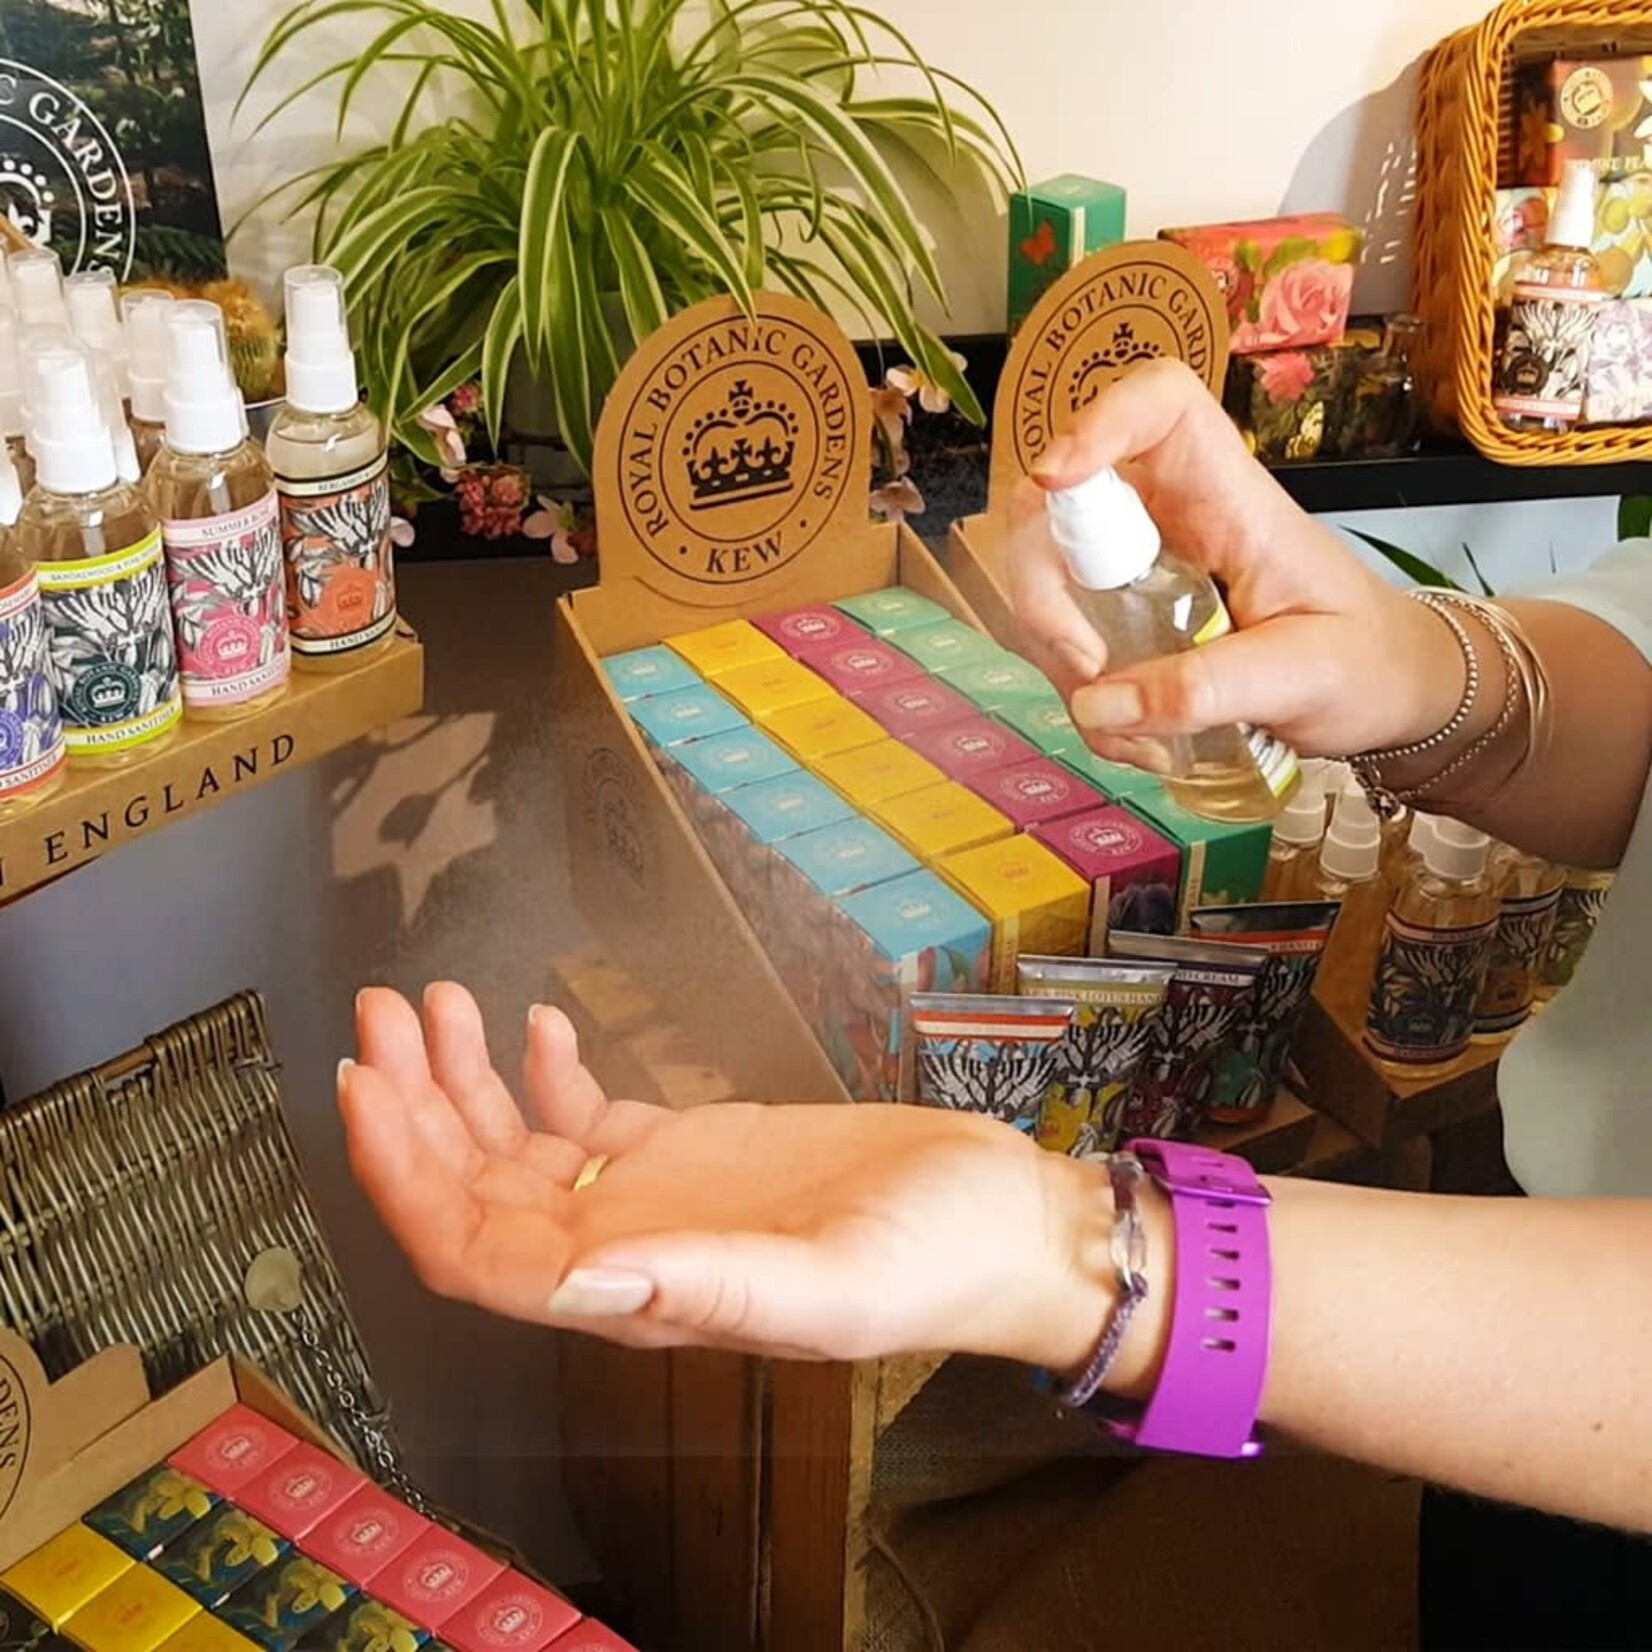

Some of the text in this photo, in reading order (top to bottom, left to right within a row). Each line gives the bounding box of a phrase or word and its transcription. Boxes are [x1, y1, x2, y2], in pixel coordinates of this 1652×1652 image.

[1046, 272, 1166, 351] BOTANIC
[1168, 289, 1206, 380] GARD
[629, 326, 846, 536] ROYAL BOTANIC GARDENS
[706, 531, 782, 574] KEW
[211, 681, 248, 696] HAND
[86, 729, 127, 745] HAND
[43, 734, 295, 866] ENGLAND
